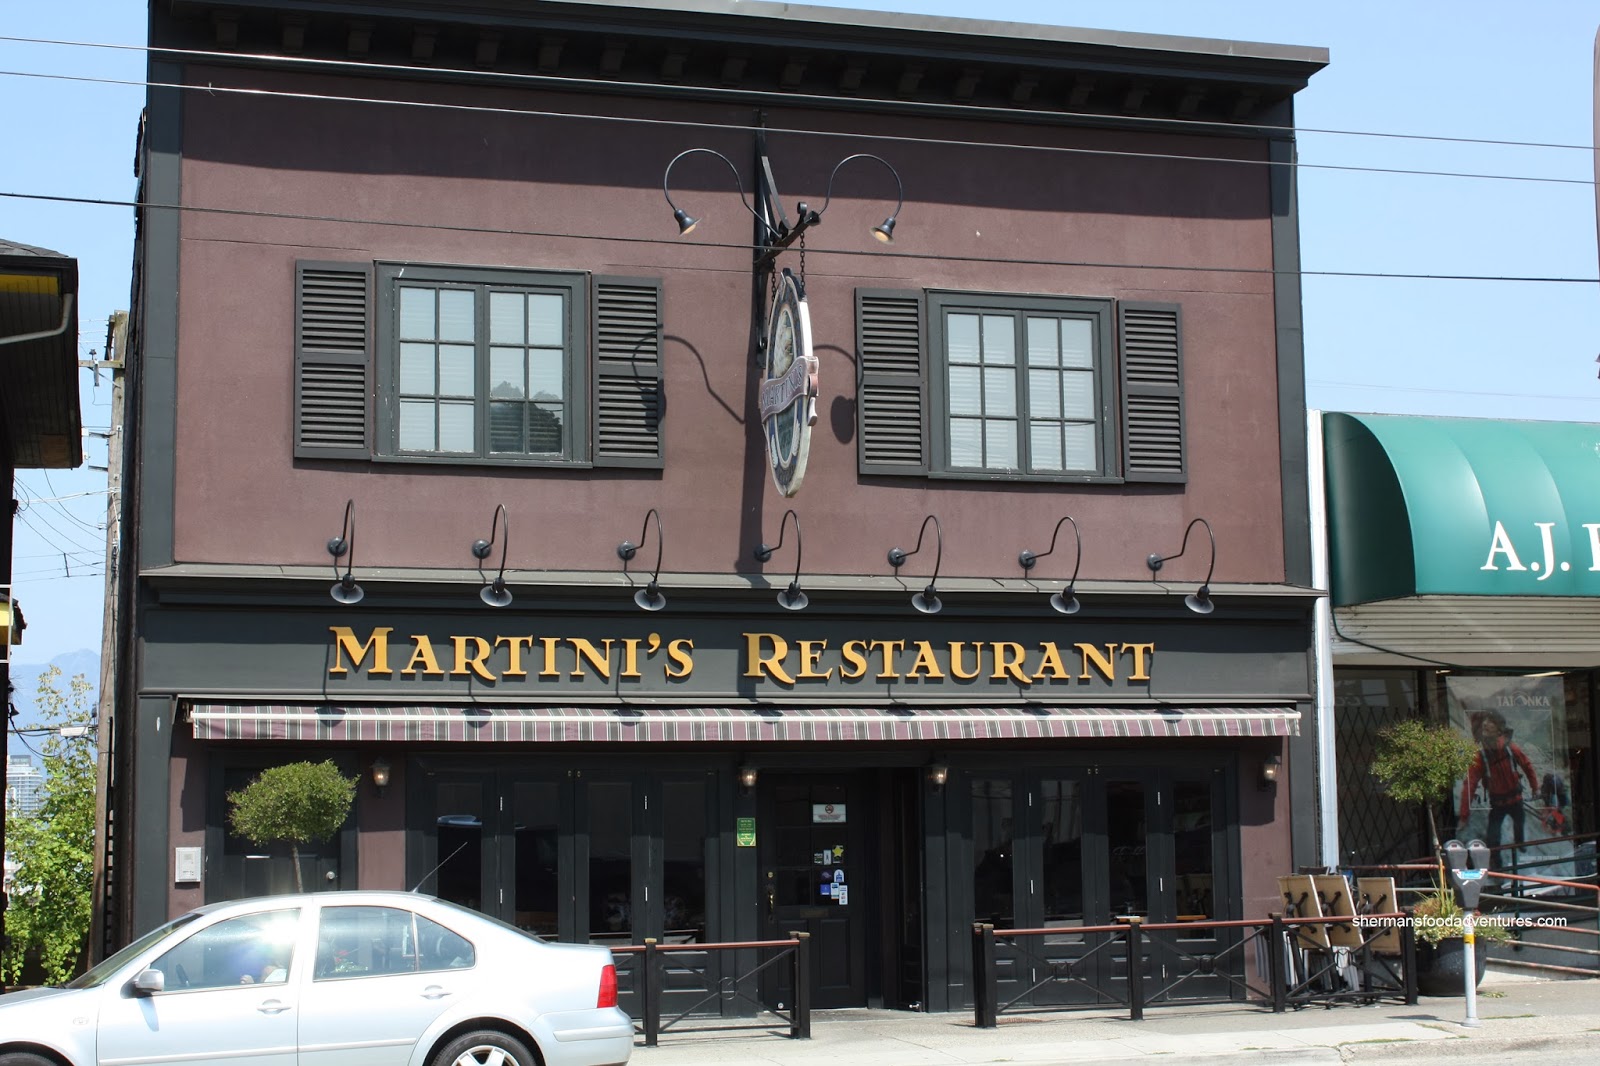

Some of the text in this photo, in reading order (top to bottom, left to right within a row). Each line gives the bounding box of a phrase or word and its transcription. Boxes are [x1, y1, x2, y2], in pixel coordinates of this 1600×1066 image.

[1480, 520, 1570, 580] A.J.
[329, 626, 1155, 684] MARTINI'S RESTAURANT
